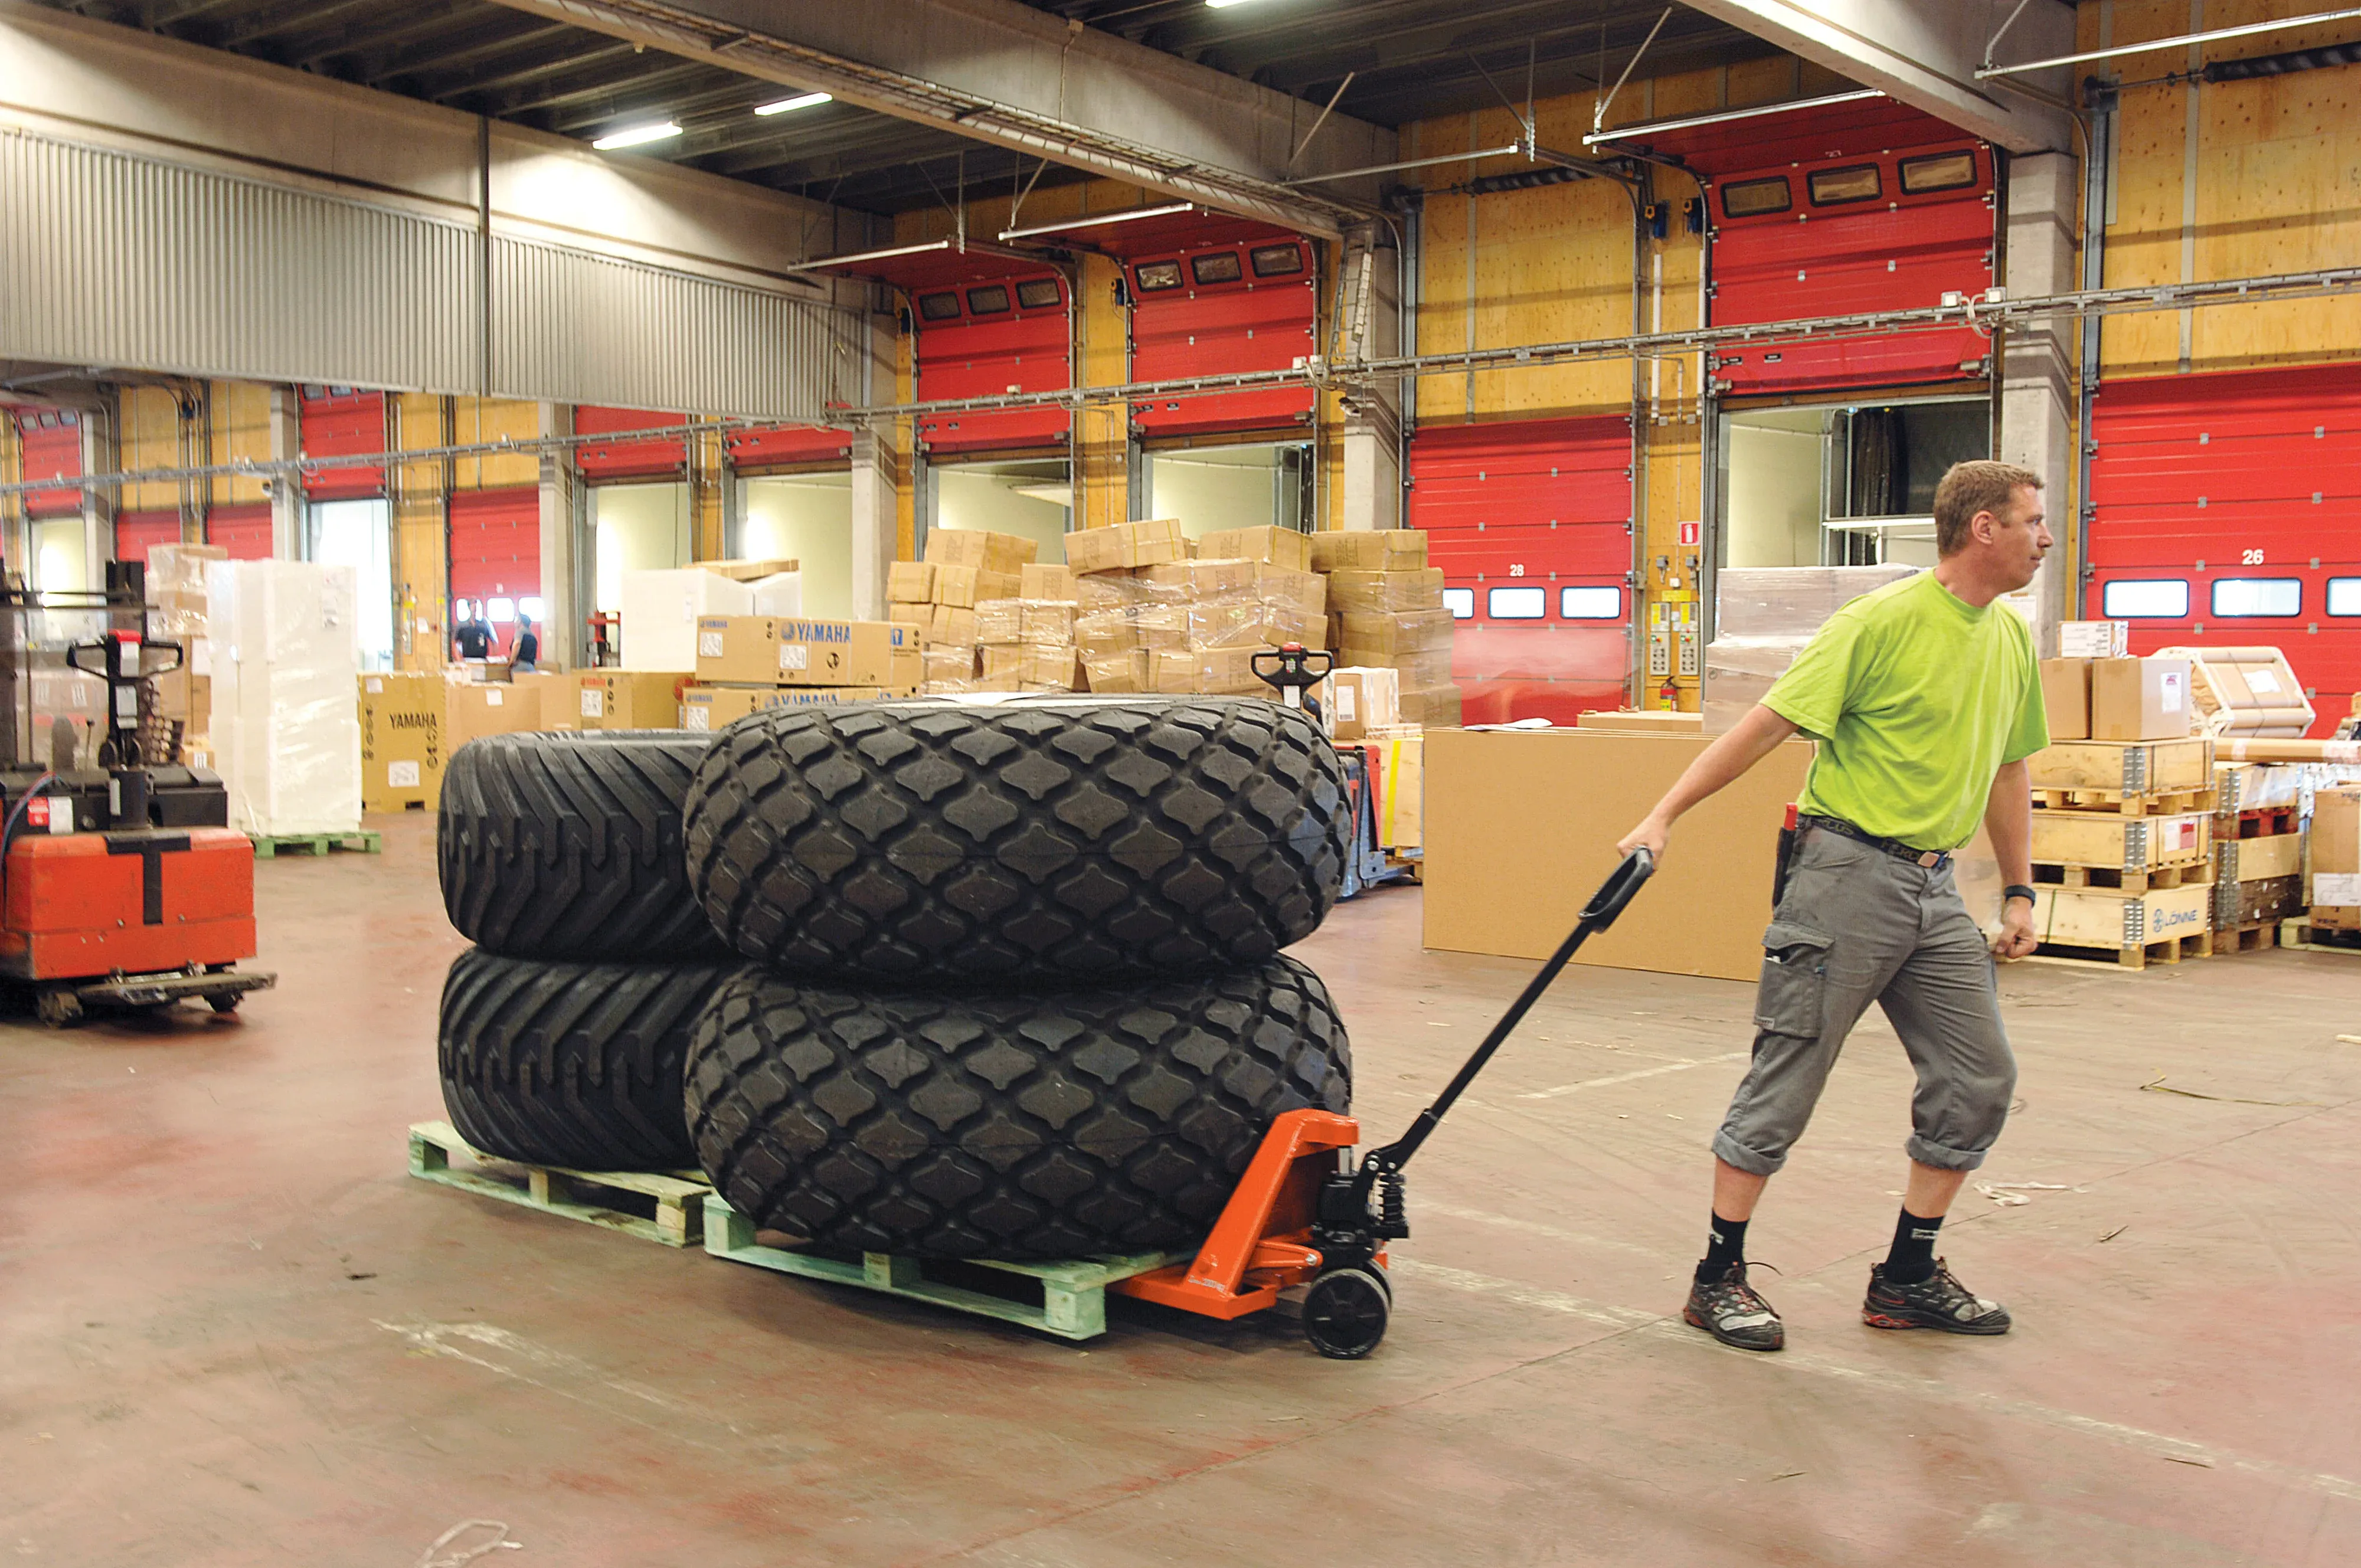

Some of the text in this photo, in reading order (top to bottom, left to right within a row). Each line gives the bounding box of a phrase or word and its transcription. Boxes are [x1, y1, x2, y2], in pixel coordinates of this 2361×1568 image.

[2242, 549, 2264, 565] 26
[1510, 564, 1524, 577] 28
[797, 623, 851, 643] YAMAHA
[388, 712, 437, 730] YAMAHA
